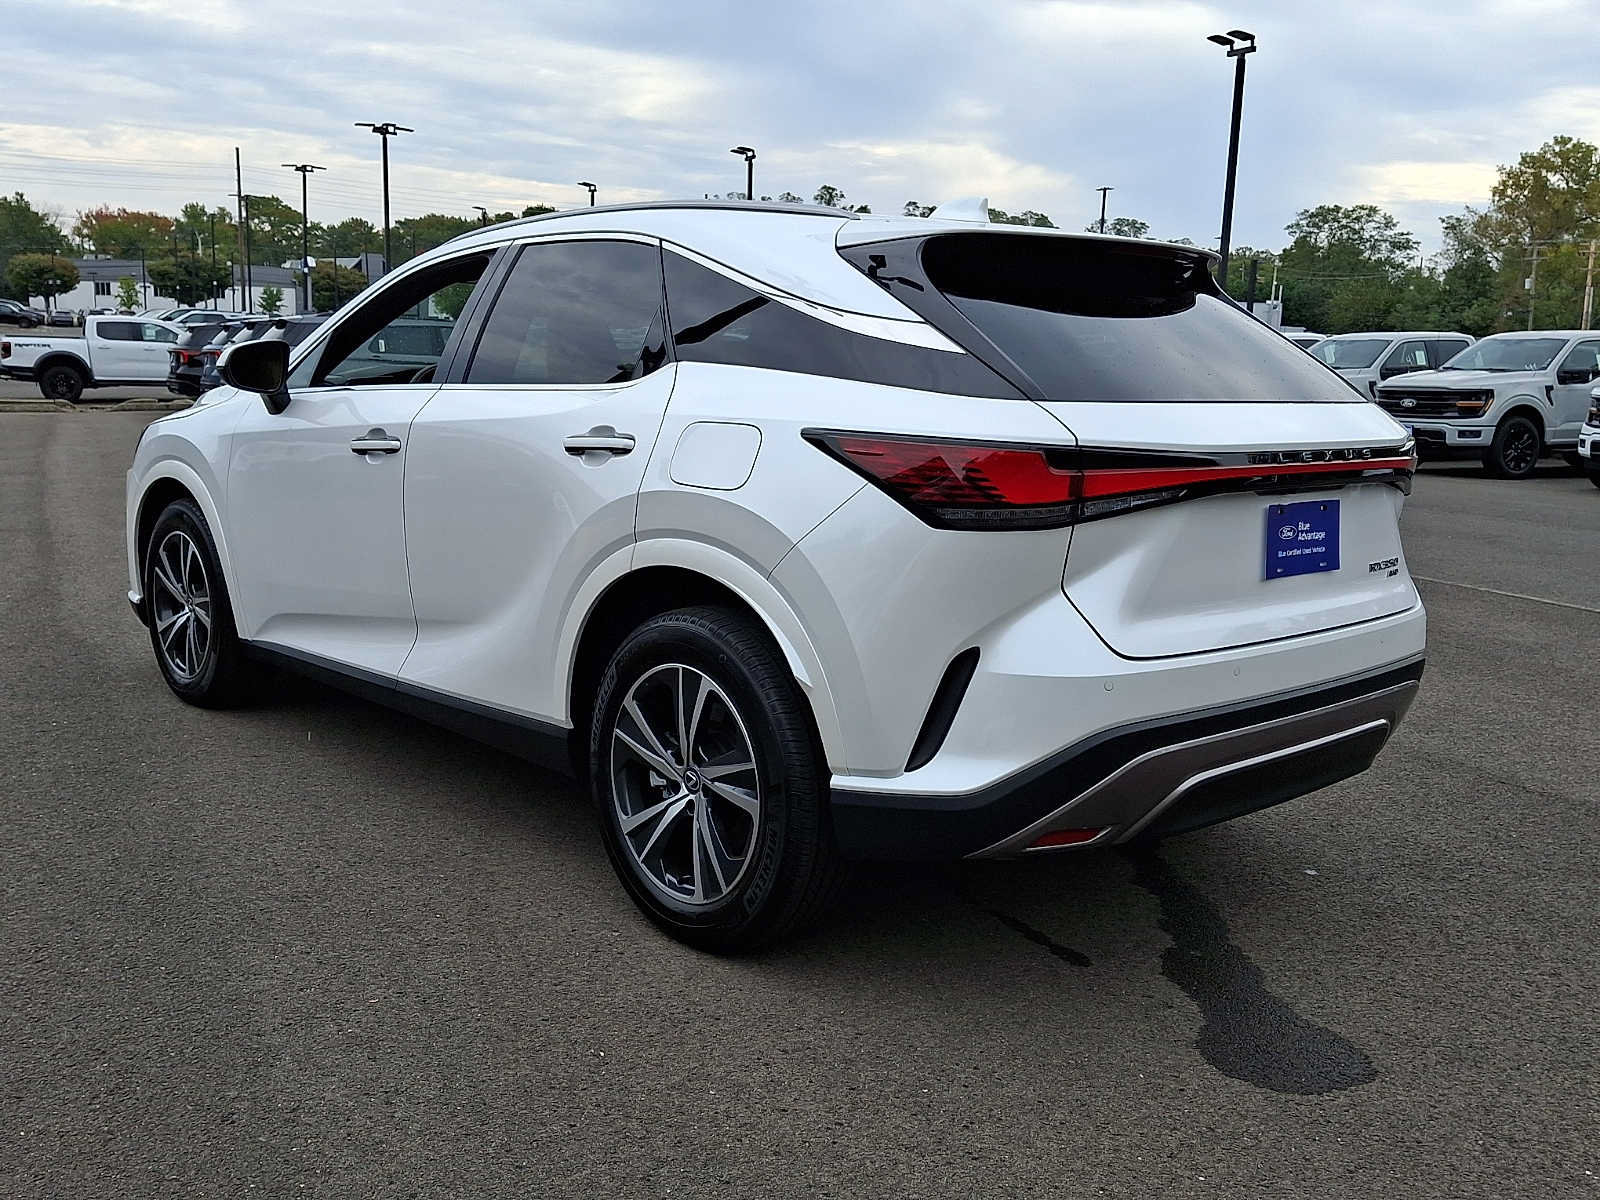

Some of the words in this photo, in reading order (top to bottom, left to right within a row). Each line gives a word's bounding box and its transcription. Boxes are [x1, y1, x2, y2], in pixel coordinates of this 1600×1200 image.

[1279, 449, 1372, 462] LEXUS
[1298, 521, 1310, 531] Blue
[1298, 531, 1326, 541] Advantage
